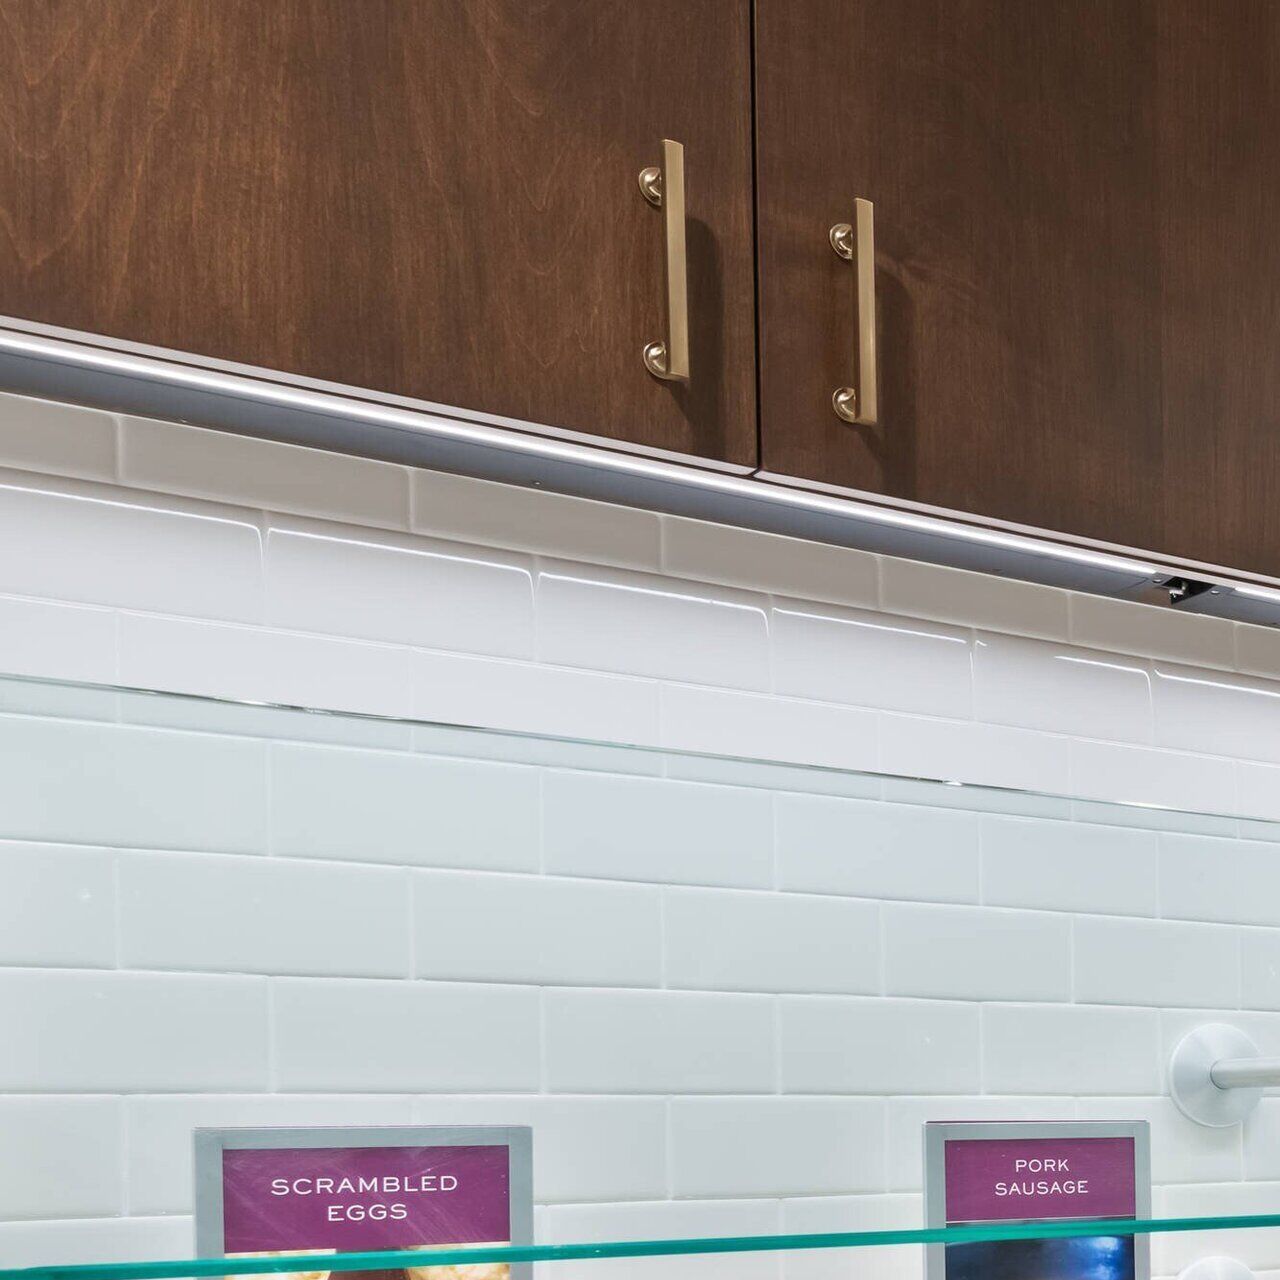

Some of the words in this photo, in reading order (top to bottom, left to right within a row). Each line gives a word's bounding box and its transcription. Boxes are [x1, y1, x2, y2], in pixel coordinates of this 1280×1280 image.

[1014, 1158, 1070, 1173] PORK
[270, 1175, 458, 1196] SCRAMBLED
[994, 1180, 1089, 1196] SAUSAGE
[327, 1203, 408, 1222] EGGS
